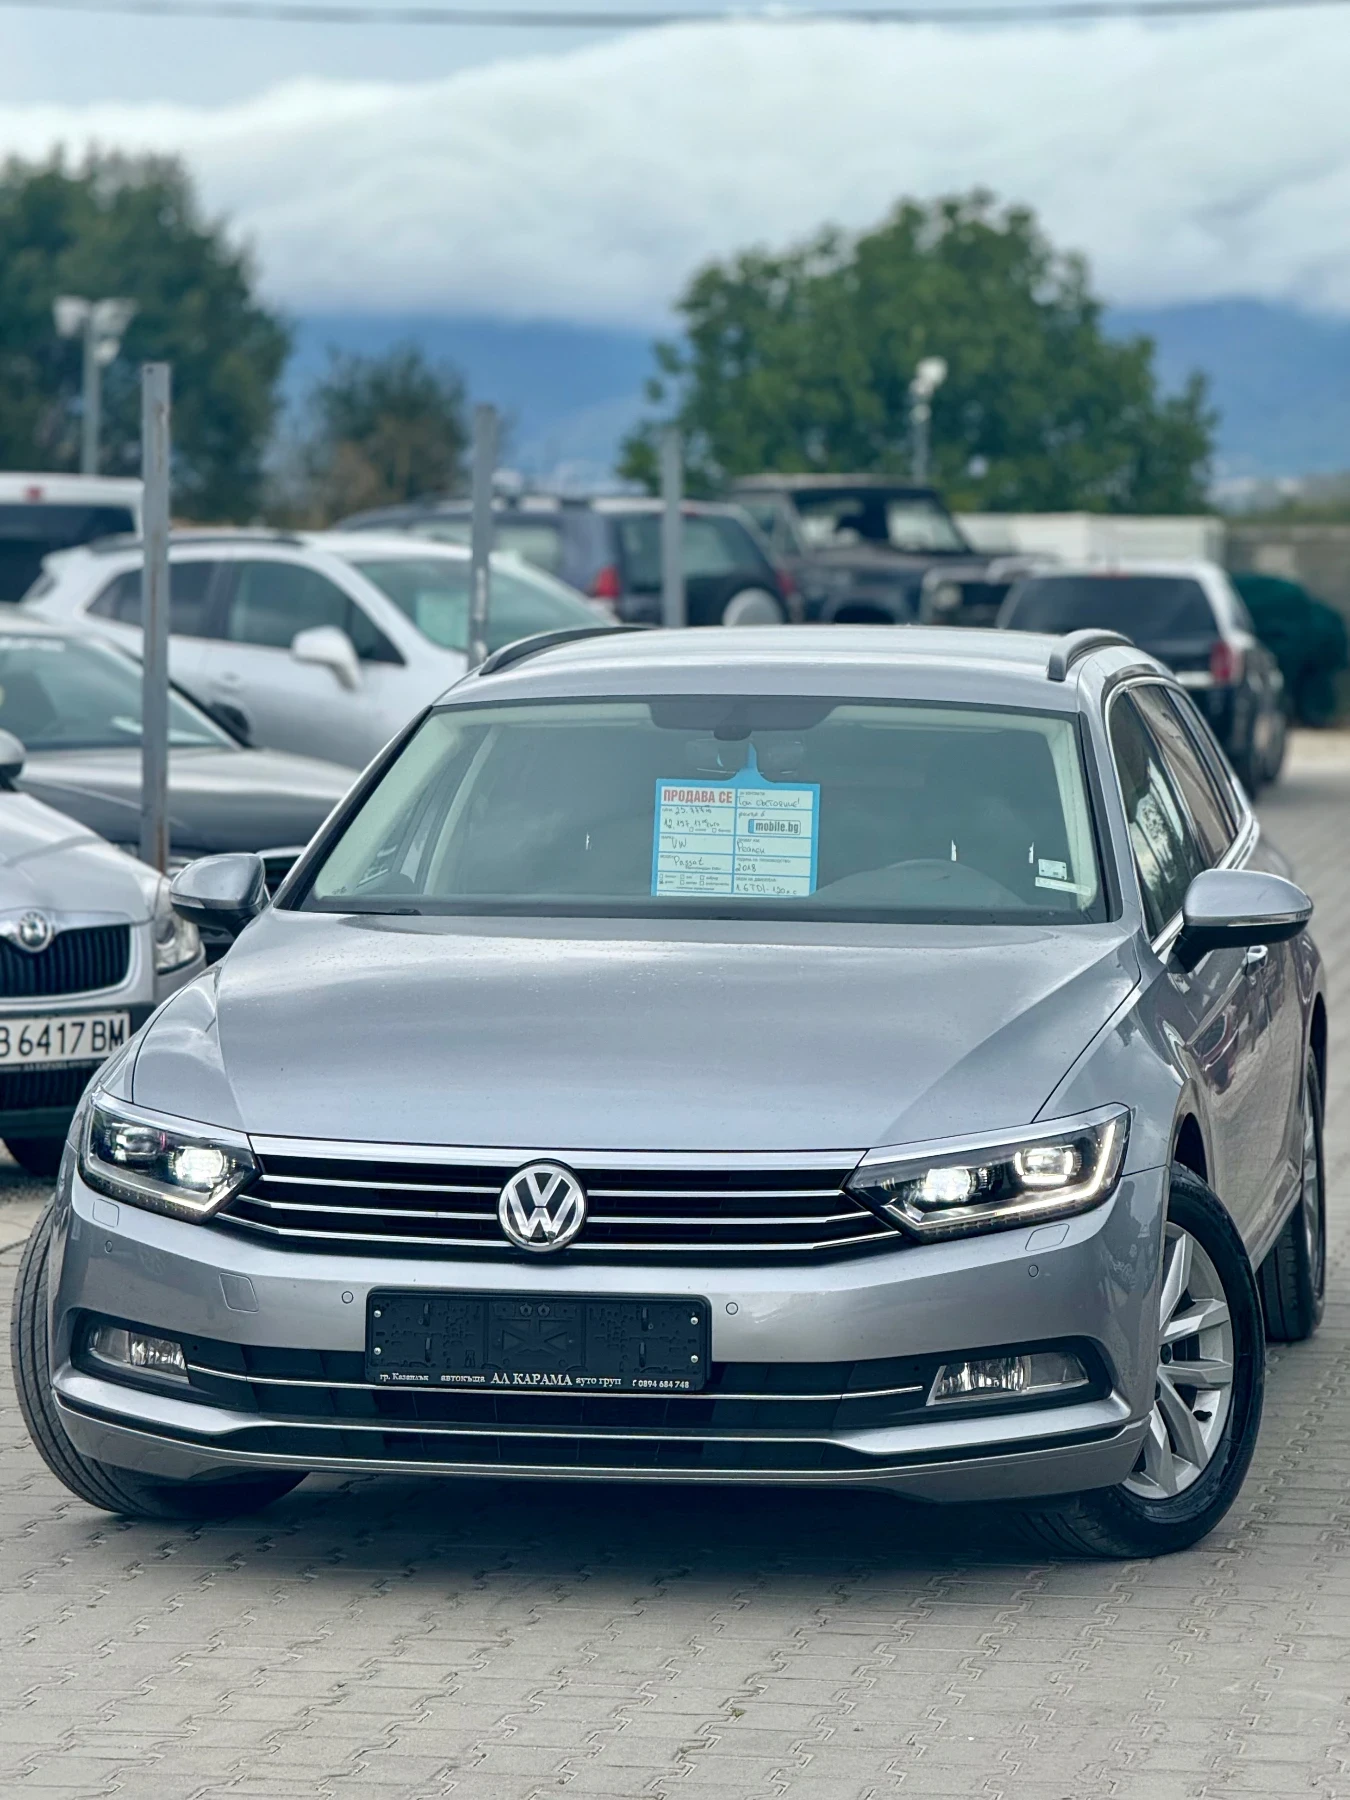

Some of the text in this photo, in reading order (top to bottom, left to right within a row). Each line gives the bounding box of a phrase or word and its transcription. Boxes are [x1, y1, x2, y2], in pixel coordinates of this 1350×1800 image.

[663, 789, 733, 804] ПРОДАВА СЕ
[755, 821, 799, 834] mobile.bg
[671, 836, 687, 849] VW
[673, 855, 705, 867] Passat
[735, 864, 757, 872] 2018
[490, 1372, 510, 1385] АЛ
[512, 1373, 573, 1386] КАРАМА
[575, 1377, 597, 1386] ауто
[598, 1377, 622, 1388] груп
[638, 1379, 658, 1388] 0894
[659, 1380, 674, 1388] 684
[674, 1380, 690, 1389] 748
